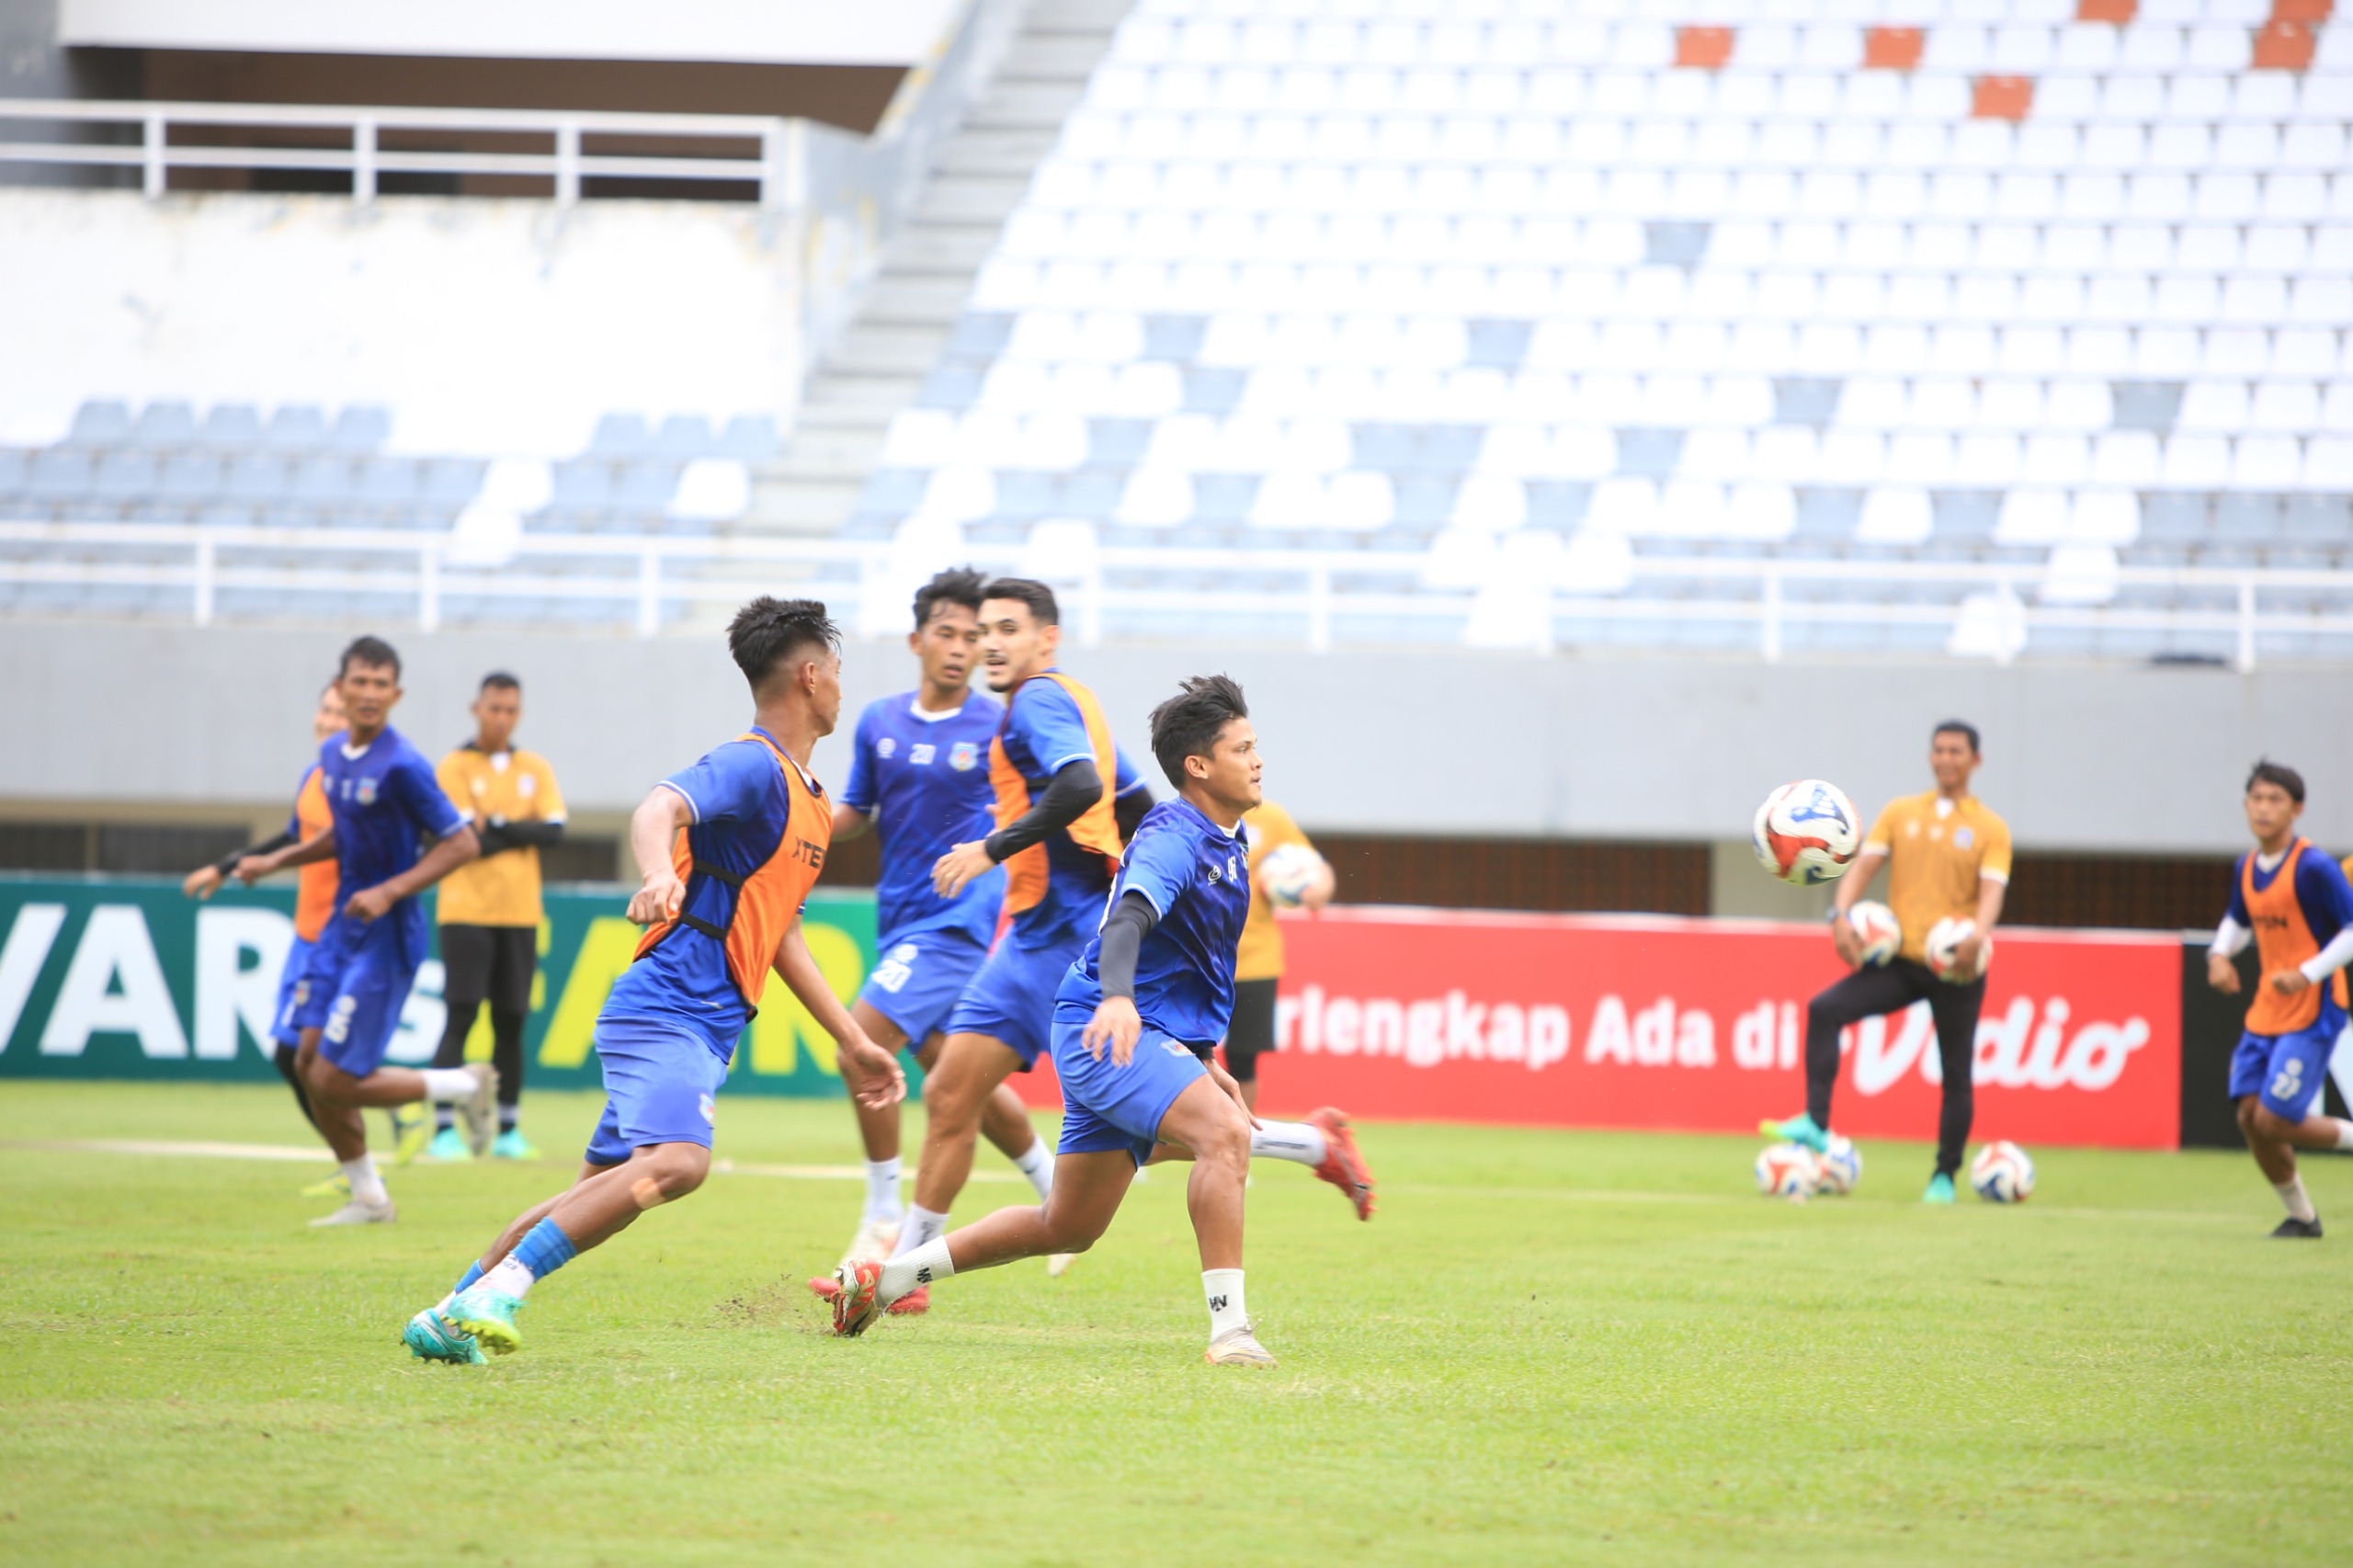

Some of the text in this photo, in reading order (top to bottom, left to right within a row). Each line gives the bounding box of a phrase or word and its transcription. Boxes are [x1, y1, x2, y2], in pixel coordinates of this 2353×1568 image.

[791, 835, 827, 870] XTE
[1273, 983, 2151, 1097] rlengkap Ada di Vdio
